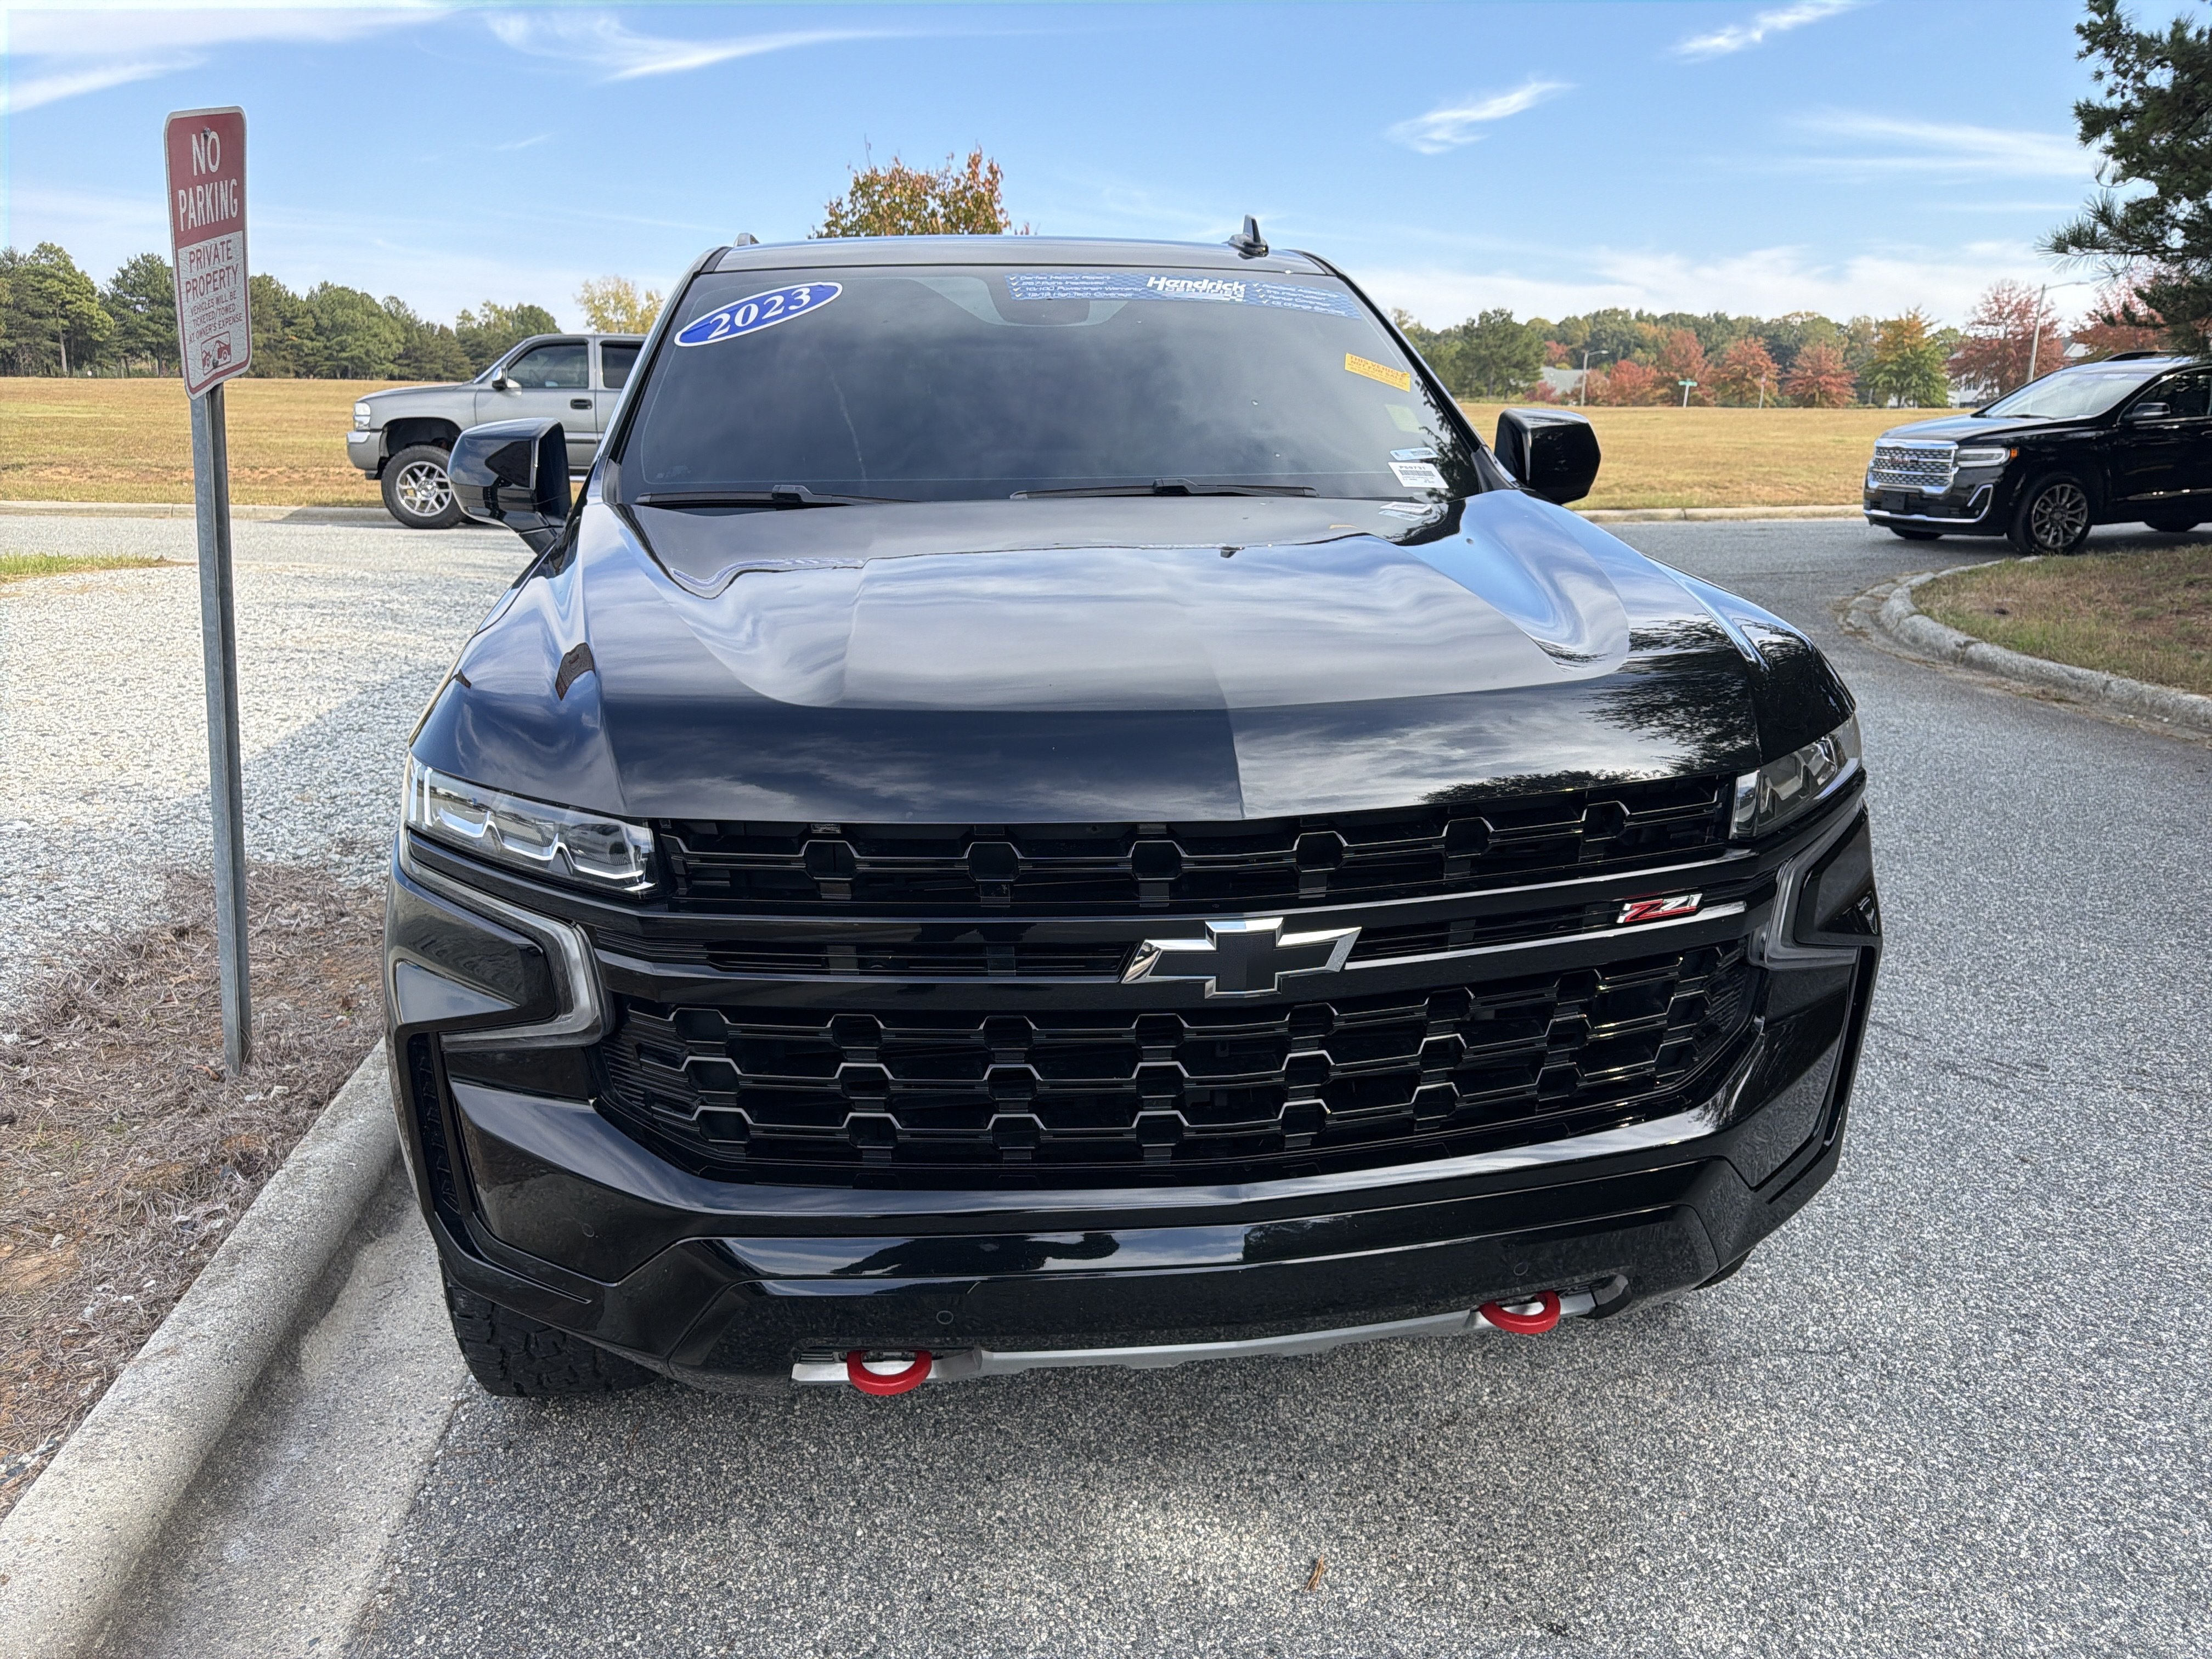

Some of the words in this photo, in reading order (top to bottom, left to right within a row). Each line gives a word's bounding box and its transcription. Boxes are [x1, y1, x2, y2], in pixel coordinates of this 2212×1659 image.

[193, 131, 221, 176] NO
[178, 178, 238, 232] PARKING
[189, 239, 233, 273] PRIVATE
[185, 263, 239, 303] PROPERTY
[1147, 276, 1246, 292] Hendrick
[190, 298, 214, 316] VEHICLES
[216, 294, 228, 305] WILL
[230, 290, 237, 300] BE
[707, 287, 811, 340] 2023
[189, 332, 195, 344] AT
[196, 323, 217, 340] OWNER'S
[218, 313, 242, 329] EXPENSE
[1350, 356, 1368, 365] THIS
[1371, 363, 1408, 378] VEHICLE
[1385, 372, 1403, 380] SALE
[1617, 893, 1703, 923] Z71
